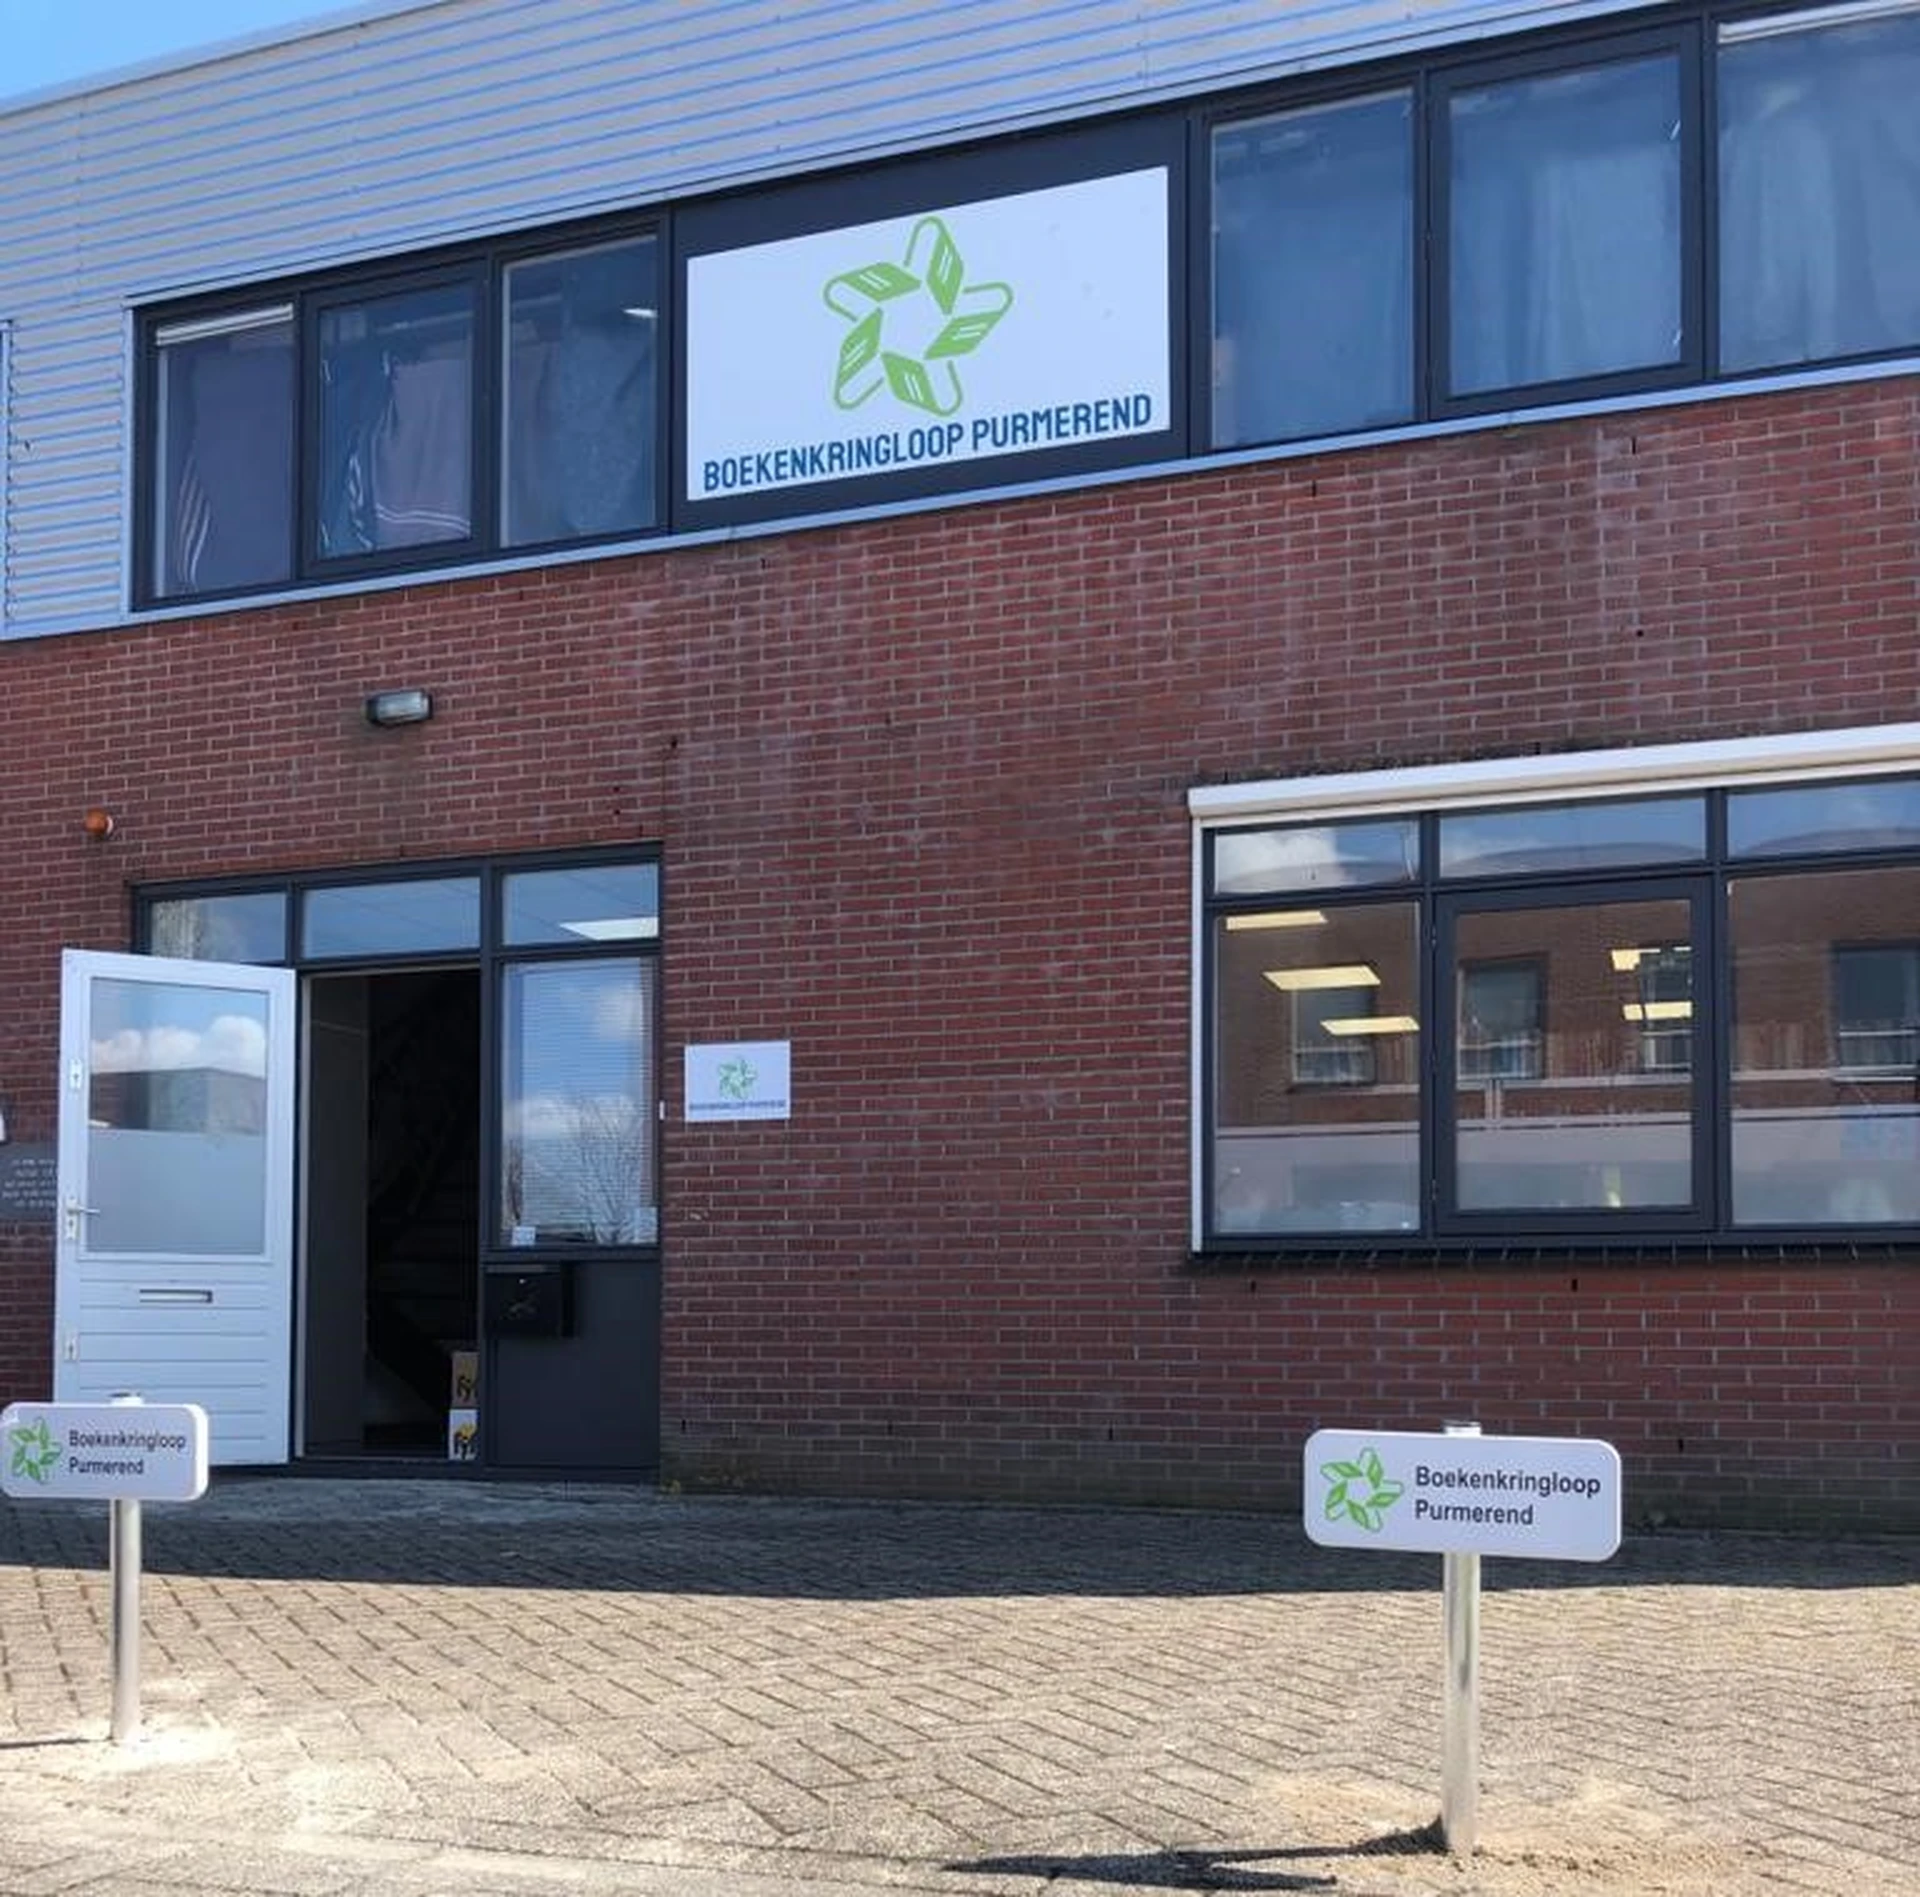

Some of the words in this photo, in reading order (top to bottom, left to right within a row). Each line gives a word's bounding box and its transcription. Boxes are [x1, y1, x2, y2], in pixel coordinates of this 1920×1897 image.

[703, 422, 963, 491] BOEKENKRINGLOOP
[972, 394, 1152, 451] PURMEREND
[69, 1430, 186, 1453] Boekenkringloop
[69, 1456, 144, 1474] Purmerend
[1415, 1466, 1600, 1498] Boekenkringloop
[1415, 1500, 1533, 1525] Purmerend
